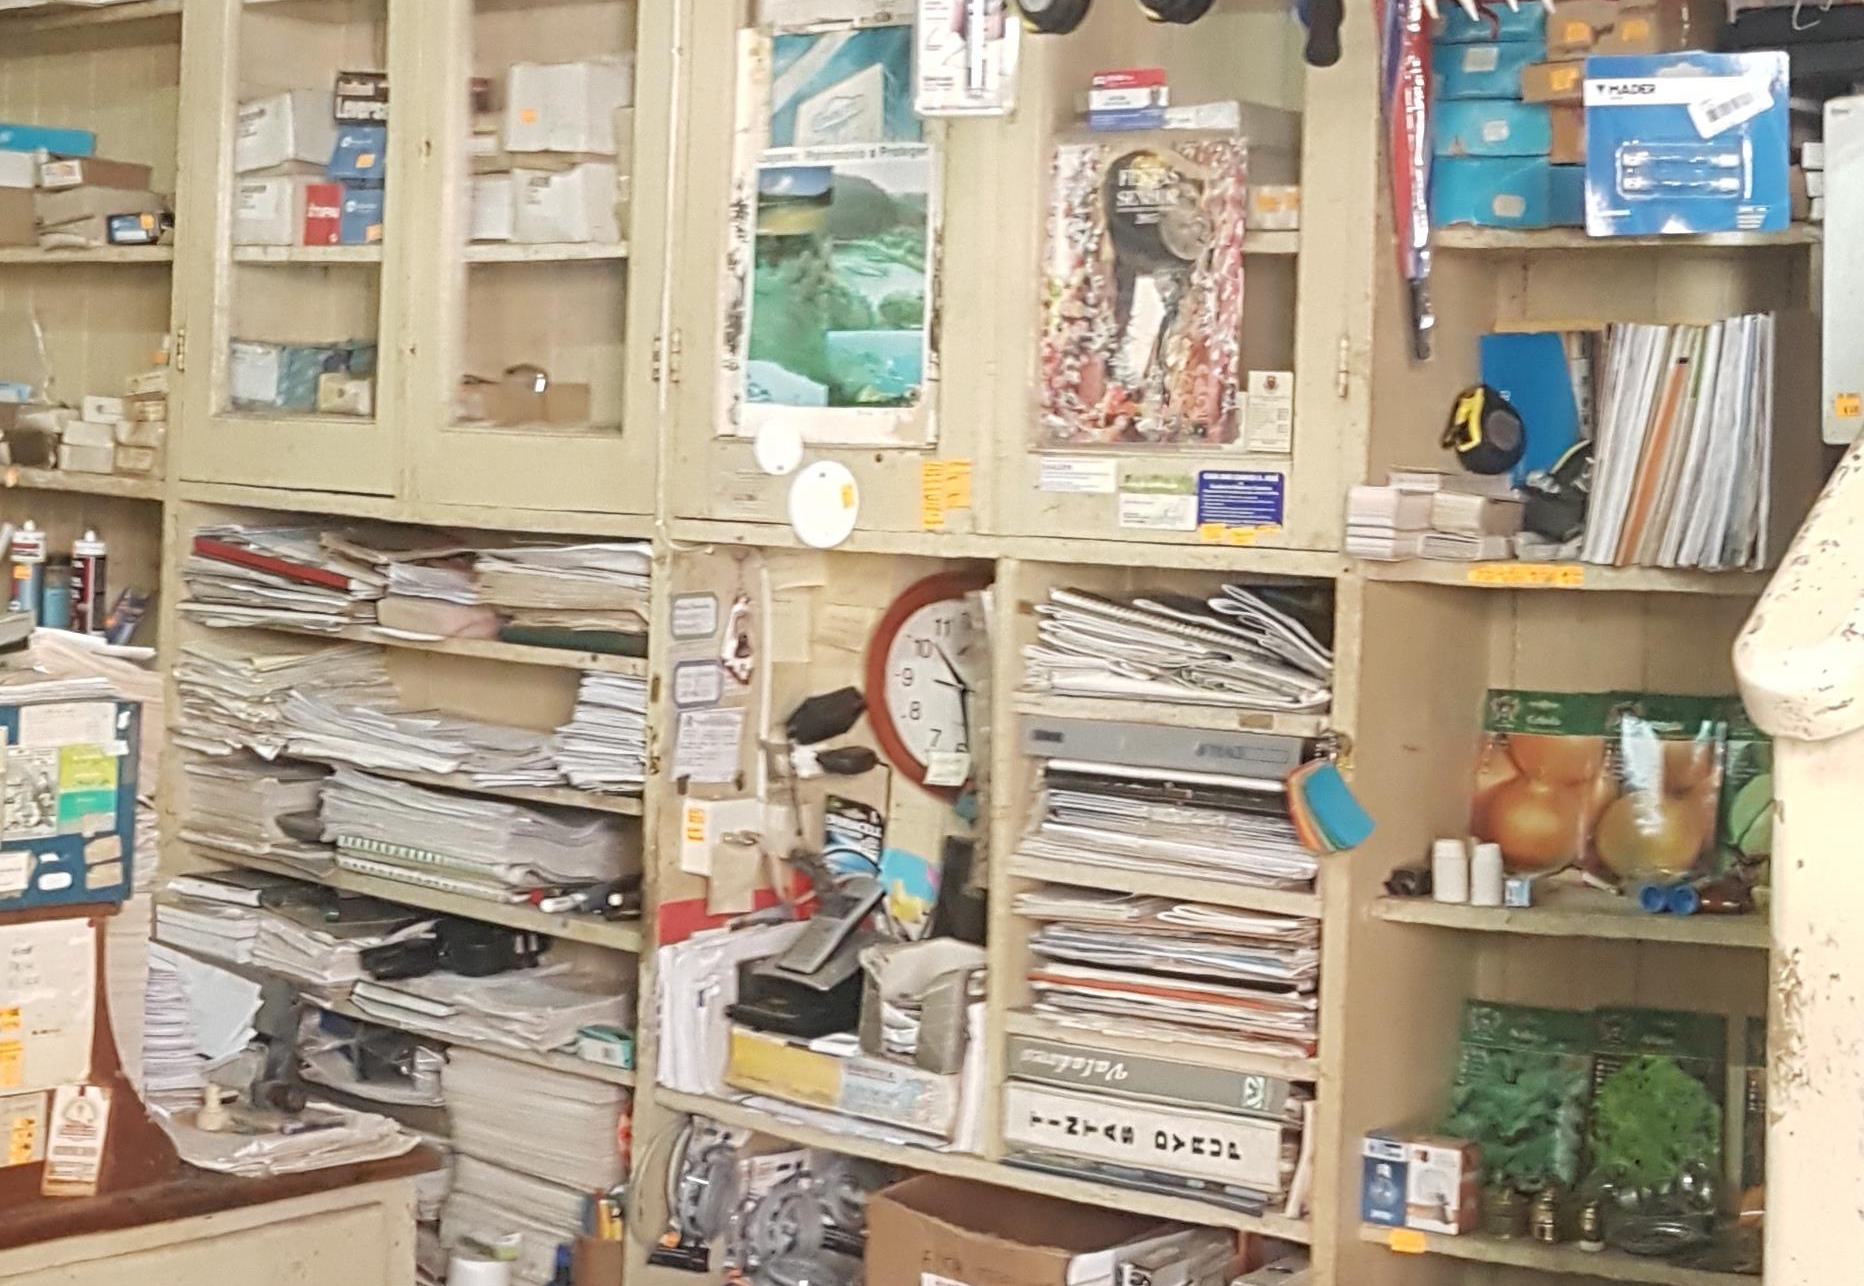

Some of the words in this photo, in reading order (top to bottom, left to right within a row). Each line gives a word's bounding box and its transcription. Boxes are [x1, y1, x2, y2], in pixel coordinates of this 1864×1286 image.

[1608, 81, 1658, 97] MADER
[933, 617, 954, 641] 11
[912, 636, 934, 661] 10
[897, 667, 915, 690] 9
[905, 699, 922, 723] 8
[928, 727, 943, 749] 7
[1029, 1109, 1136, 1146] TINTAS
[1153, 1128, 1245, 1163] DYRUP
